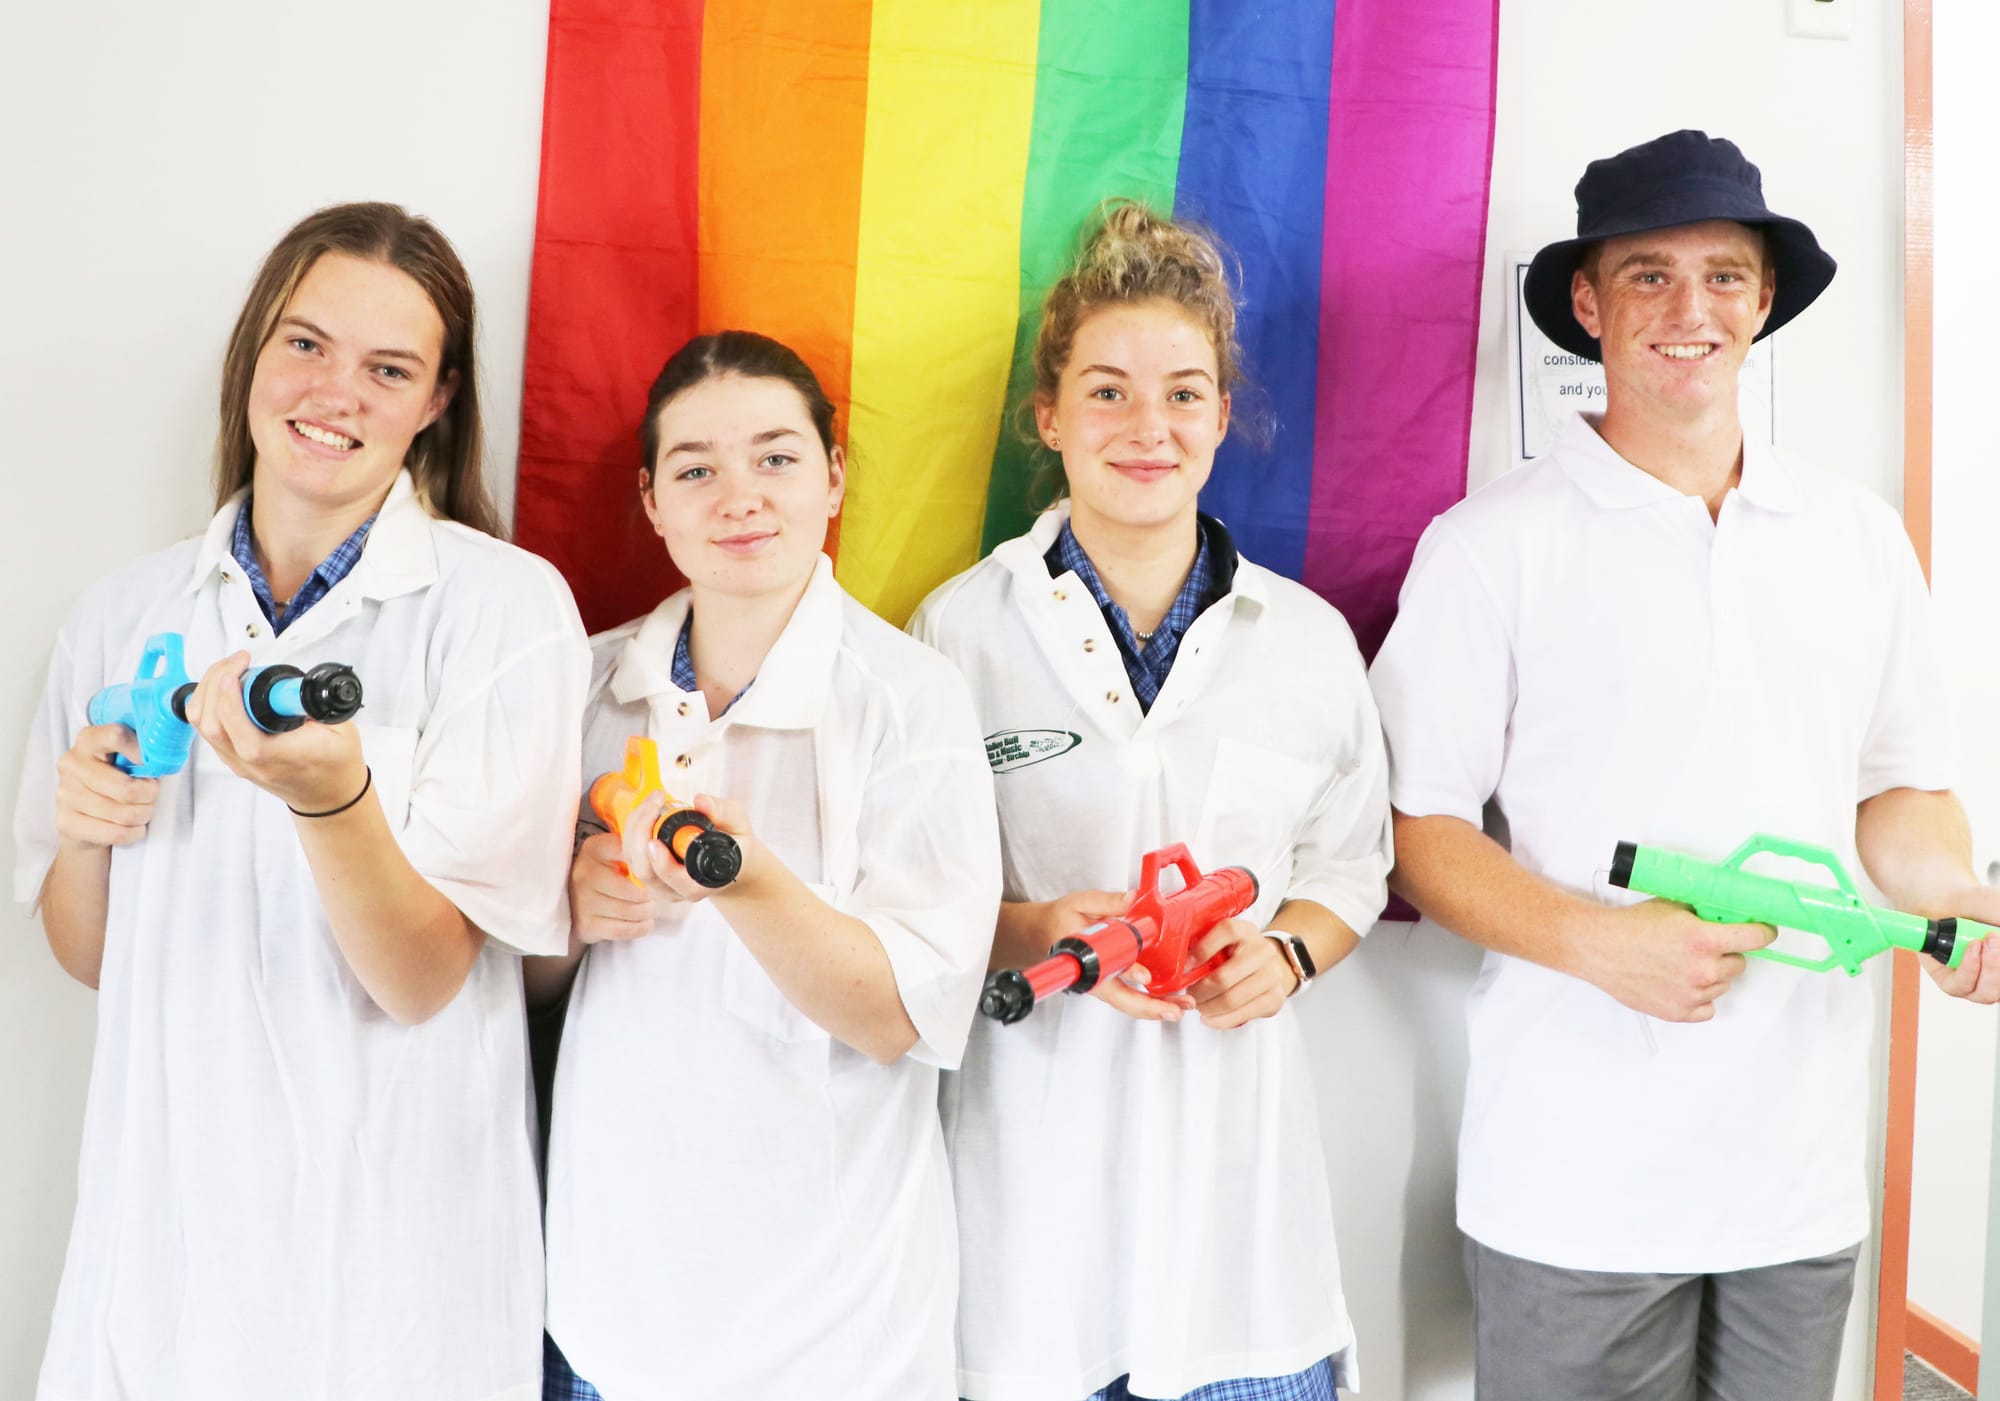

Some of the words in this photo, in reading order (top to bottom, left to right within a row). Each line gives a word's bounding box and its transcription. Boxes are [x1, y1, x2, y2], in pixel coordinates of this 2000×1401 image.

[1559, 382, 1582, 395] and
[1004, 735, 1019, 746] Bull
[1000, 744, 1022, 755] Music
